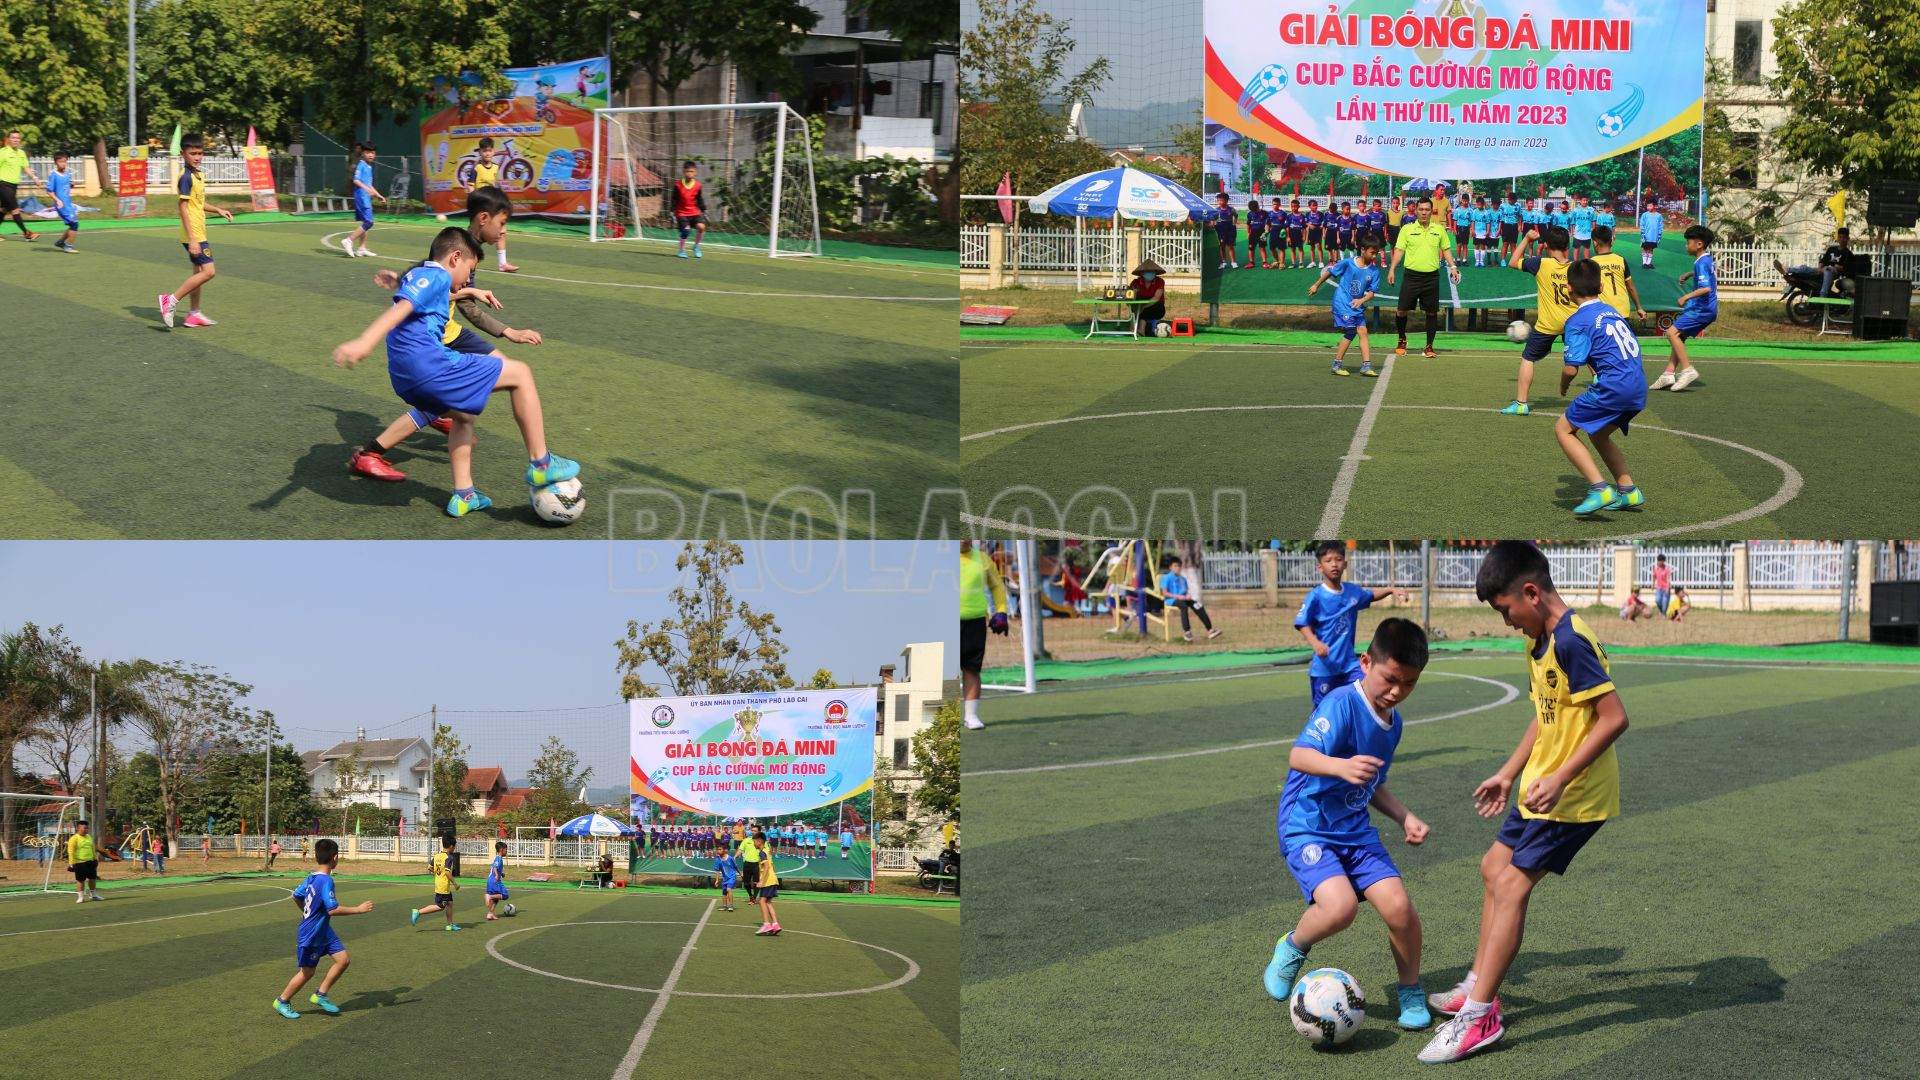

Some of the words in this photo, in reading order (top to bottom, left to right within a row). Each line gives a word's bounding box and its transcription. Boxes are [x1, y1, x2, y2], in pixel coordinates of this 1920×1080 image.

[1279, 5, 1358, 46] GIẢI
[1370, 11, 1474, 49] BÓNG
[1484, 13, 1540, 50] ĐÁ
[1551, 19, 1631, 51] MINI
[1296, 63, 1344, 86] CUP
[1353, 56, 1401, 87] BẮC
[1409, 61, 1492, 89] CƯỜNG
[1500, 59, 1538, 90] MỞ
[1546, 64, 1612, 95] RỘNG
[1336, 95, 1376, 121] LẦN
[1383, 99, 1425, 122] THỨ
[1429, 103, 1455, 125] III,
[1462, 101, 1510, 124] NĂM
[1517, 105, 1567, 125] 2023
[1440, 136, 1451, 146] 17
[1484, 136, 1497, 147] 03
[1523, 138, 1548, 148] 2023
[1130, 187, 1162, 199] 5G
[1605, 272, 1617, 296] 7
[1605, 319, 1640, 361] 18
[664, 739, 701, 759] GIẢI
[706, 739, 757, 758] BÓNG
[762, 738, 789, 757] ĐÁ
[794, 740, 836, 756] MINI
[672, 765, 695, 776] CUP
[698, 761, 722, 776] BẮC
[768, 760, 788, 775] MỞ
[792, 761, 826, 777] RỘNG
[712, 780, 733, 792] THỨ
[777, 781, 803, 792] 2023
